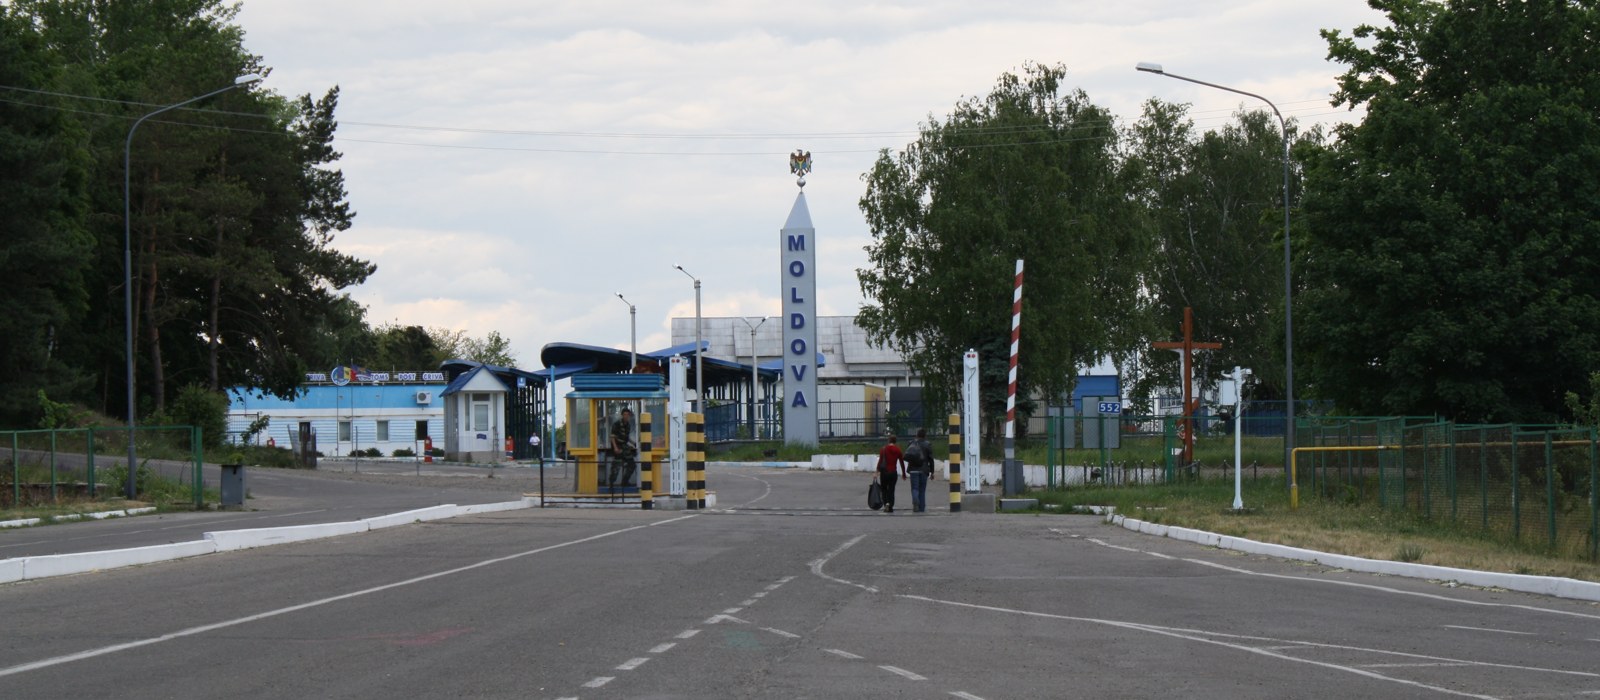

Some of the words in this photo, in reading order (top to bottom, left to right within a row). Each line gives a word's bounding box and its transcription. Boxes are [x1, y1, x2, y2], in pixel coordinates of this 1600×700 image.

[788, 234, 808, 408] MOLDOVA
[398, 373, 416, 381] POST
[422, 373, 444, 381] CRIVA
[1100, 403, 1120, 412] 552
